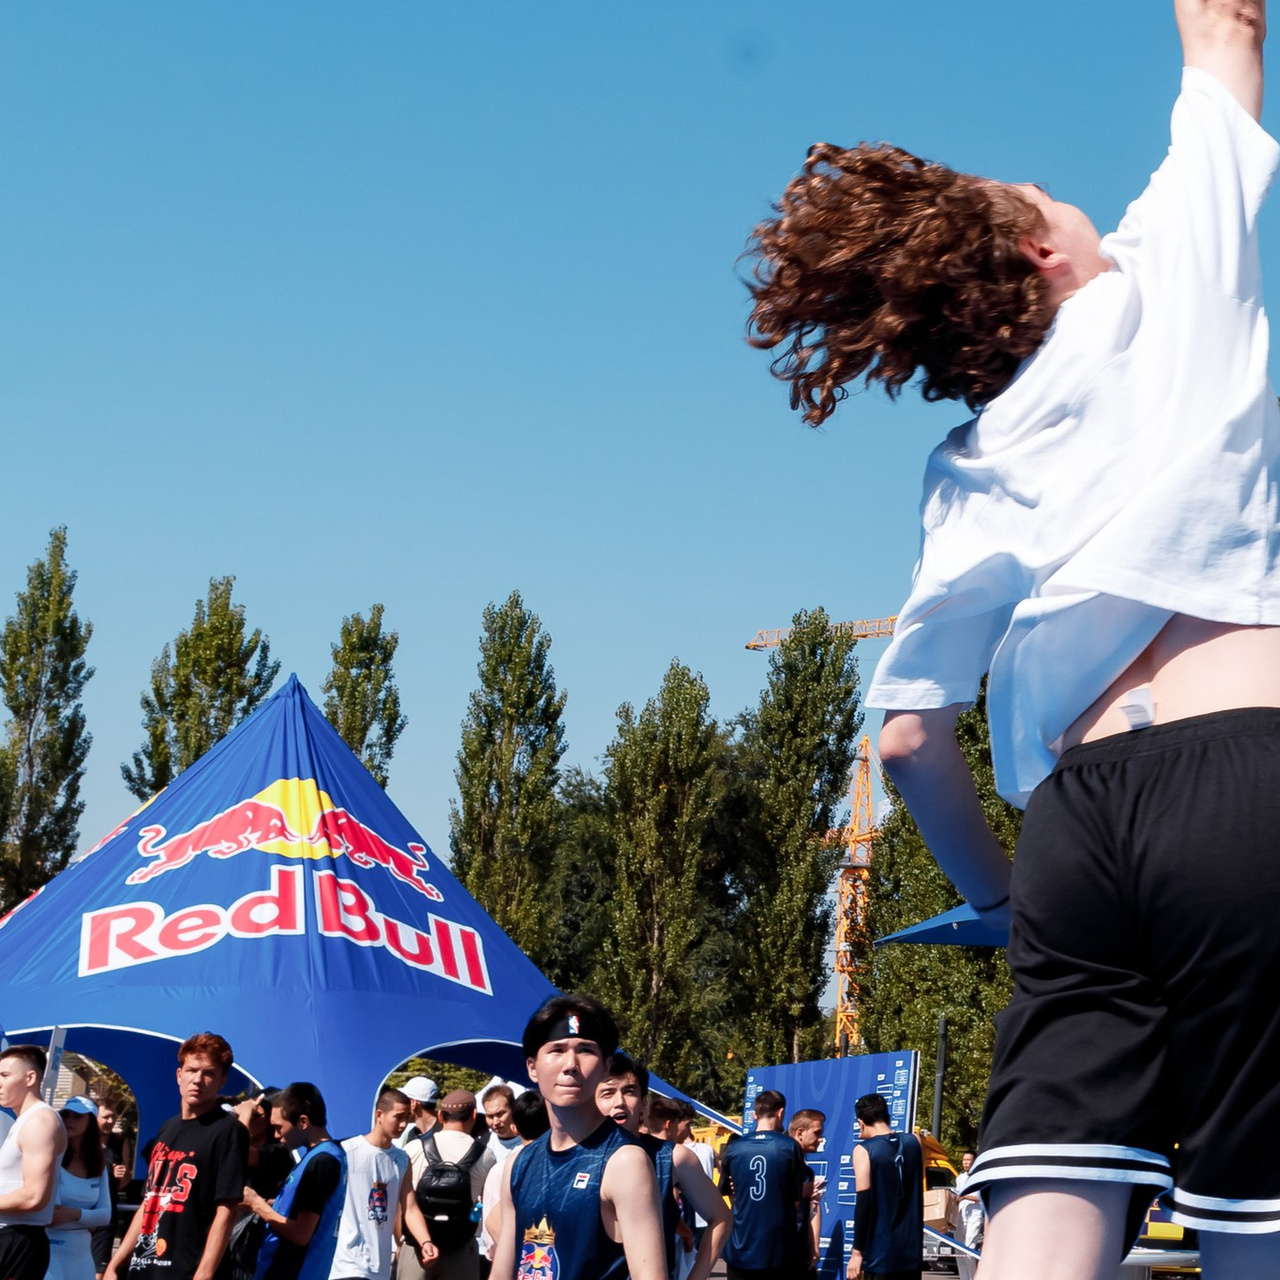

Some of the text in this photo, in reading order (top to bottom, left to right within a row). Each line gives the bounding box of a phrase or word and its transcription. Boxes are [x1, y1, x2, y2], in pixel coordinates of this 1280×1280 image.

[79, 866, 493, 996] Red Bull
[749, 1154, 767, 1202] 3
